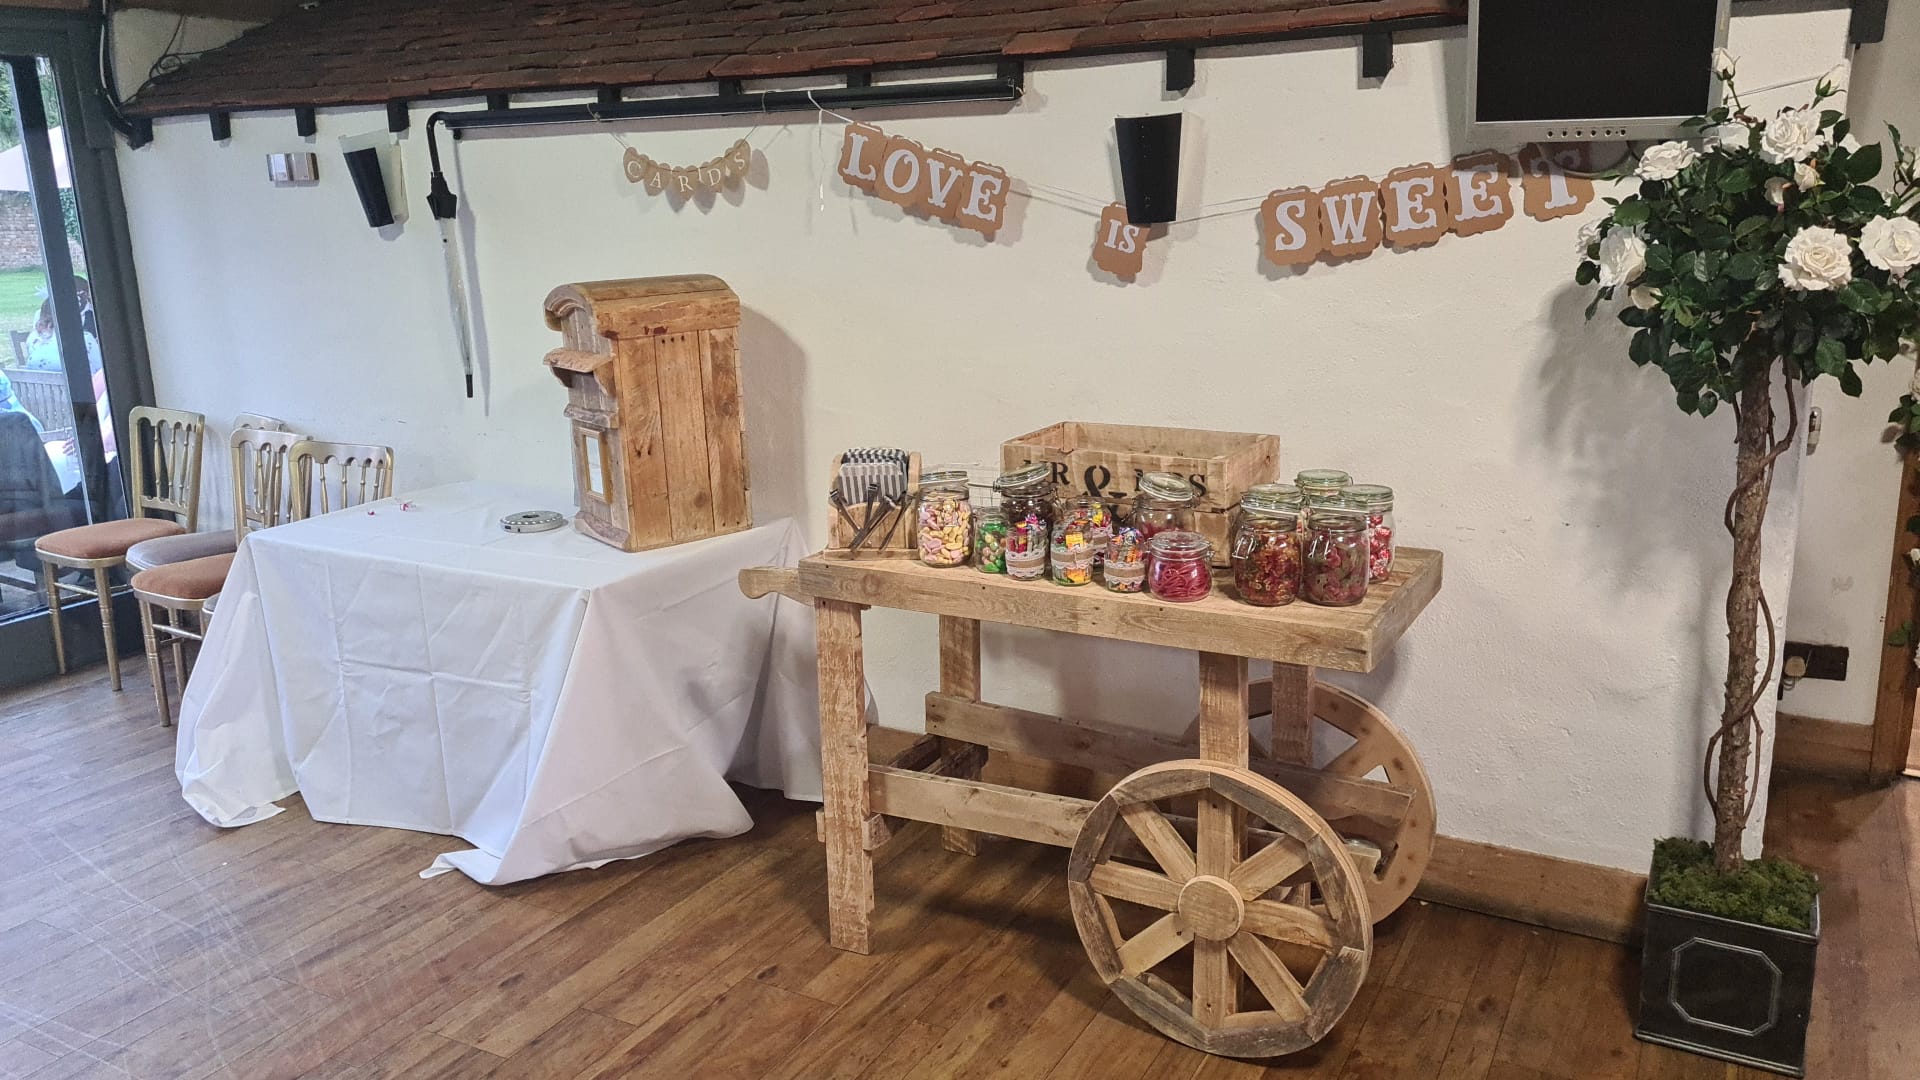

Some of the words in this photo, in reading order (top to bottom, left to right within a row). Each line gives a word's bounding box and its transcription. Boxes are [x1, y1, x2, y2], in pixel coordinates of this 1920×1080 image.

[627, 152, 745, 193] CARDS
[842, 131, 1004, 223] LOVE
[1103, 218, 1140, 254] IS
[1274, 148, 1582, 251] SWEET
